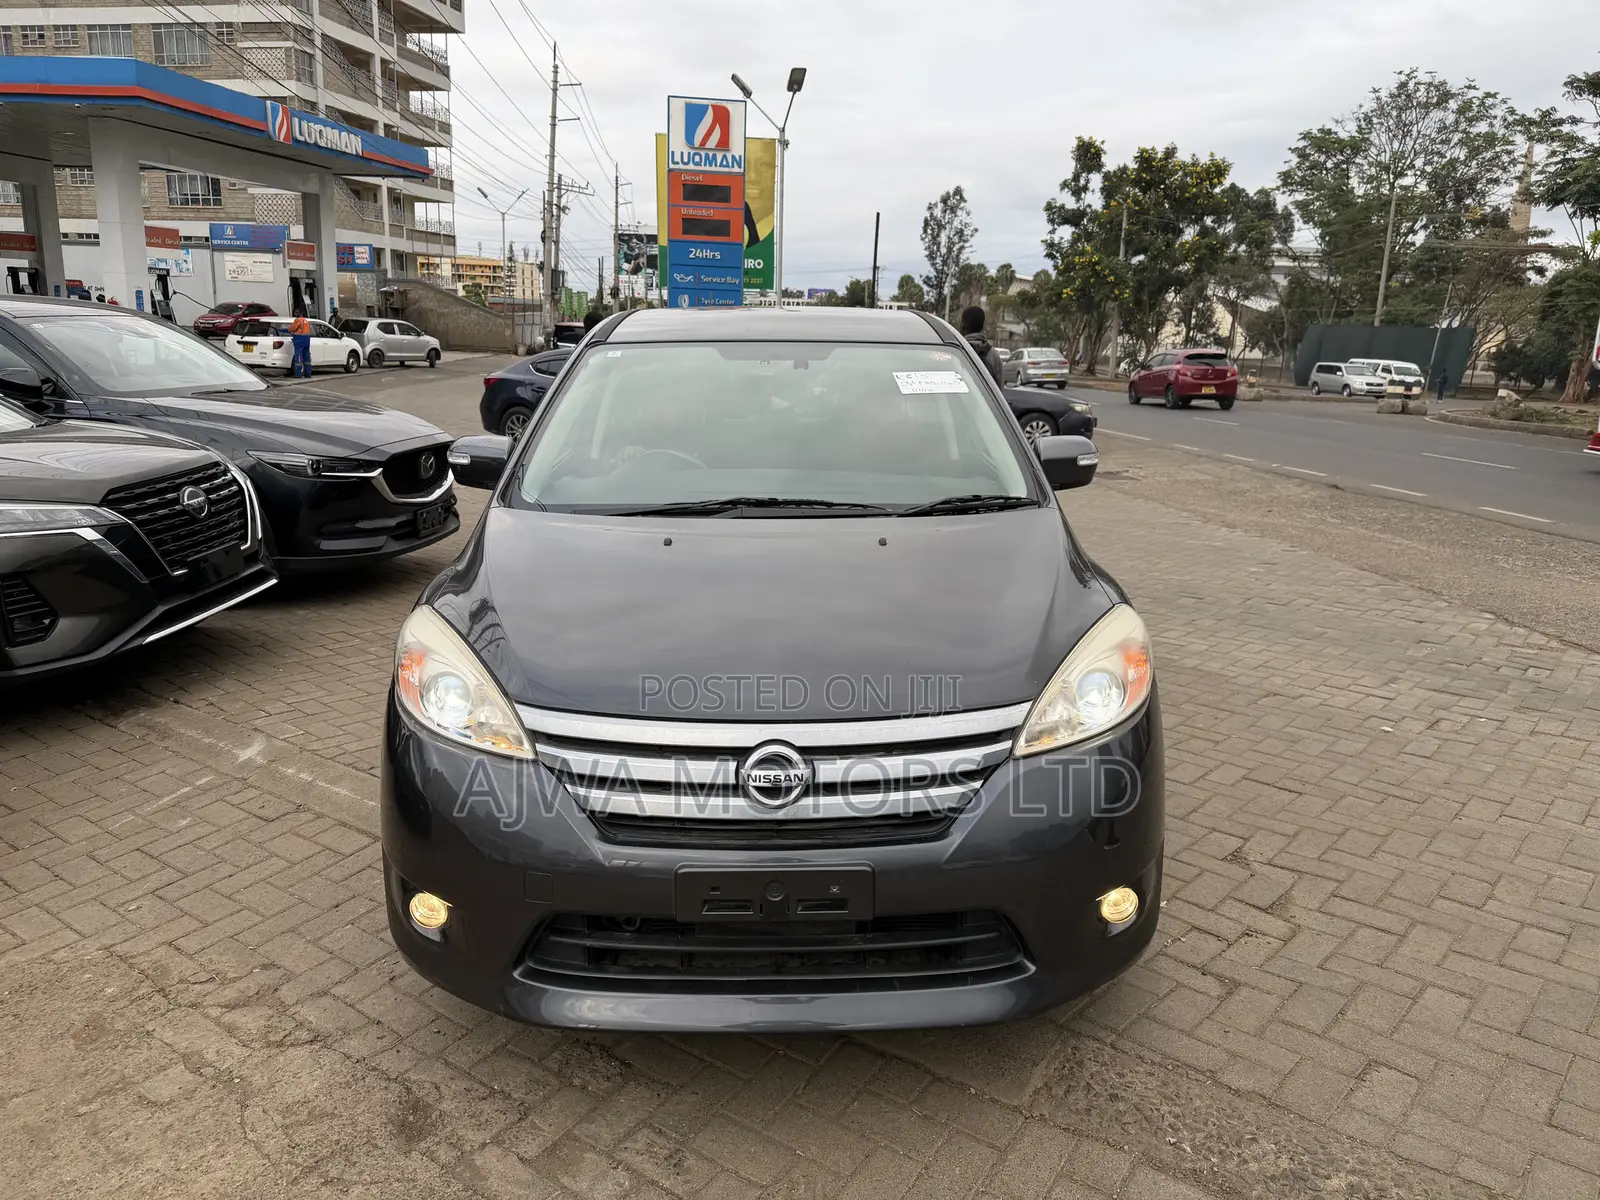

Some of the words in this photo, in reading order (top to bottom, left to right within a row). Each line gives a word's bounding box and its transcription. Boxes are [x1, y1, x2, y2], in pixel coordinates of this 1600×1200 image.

[292, 117, 362, 156] LUQMAN
[671, 151, 742, 169] LUQMAN
[681, 173, 703, 182] Diesel
[681, 208, 714, 217] Unleaded
[688, 248, 721, 260] 24Hrs
[701, 275, 726, 283] Service
[726, 276, 740, 285] Bay
[746, 773, 805, 785] NISSAN
